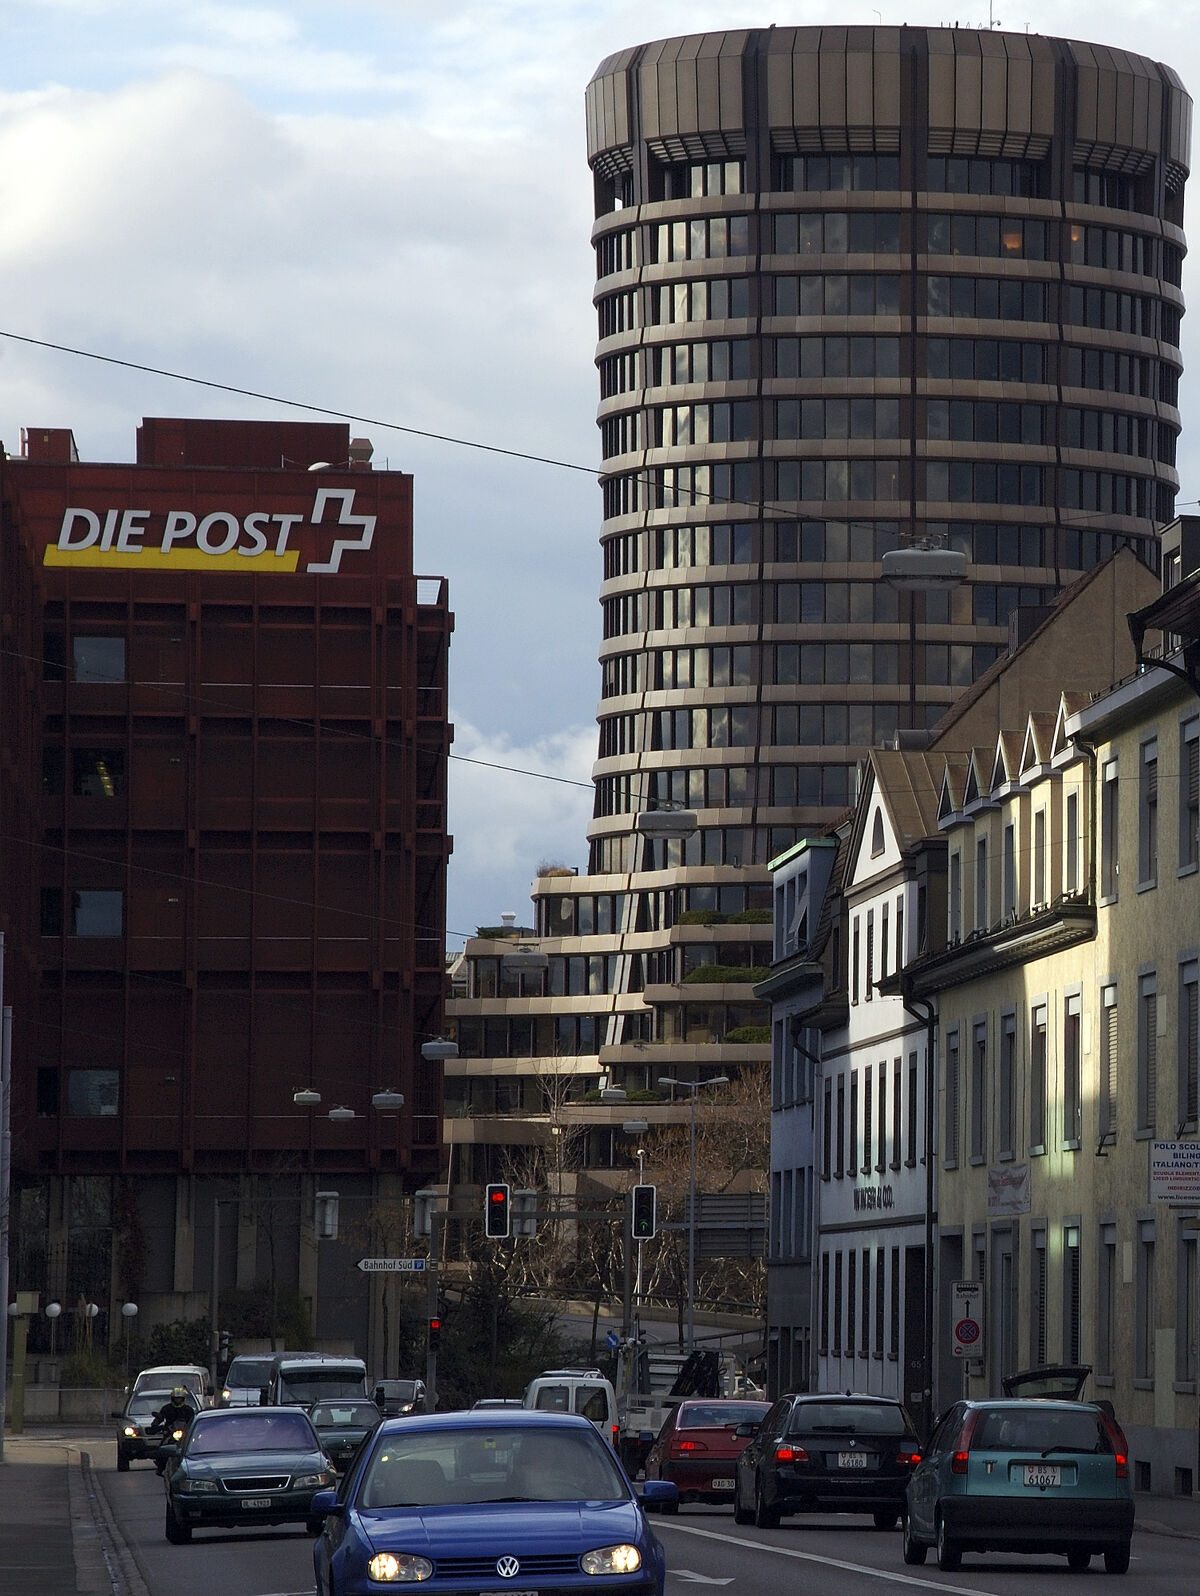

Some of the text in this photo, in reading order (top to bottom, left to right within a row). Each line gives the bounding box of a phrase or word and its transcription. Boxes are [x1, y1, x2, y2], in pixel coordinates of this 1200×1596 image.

[57, 507, 304, 558] DIE POST
[364, 1260, 396, 1270] Bahnhof
[398, 1260, 413, 1270] Süd
[1028, 1474, 1056, 1486] 61067
